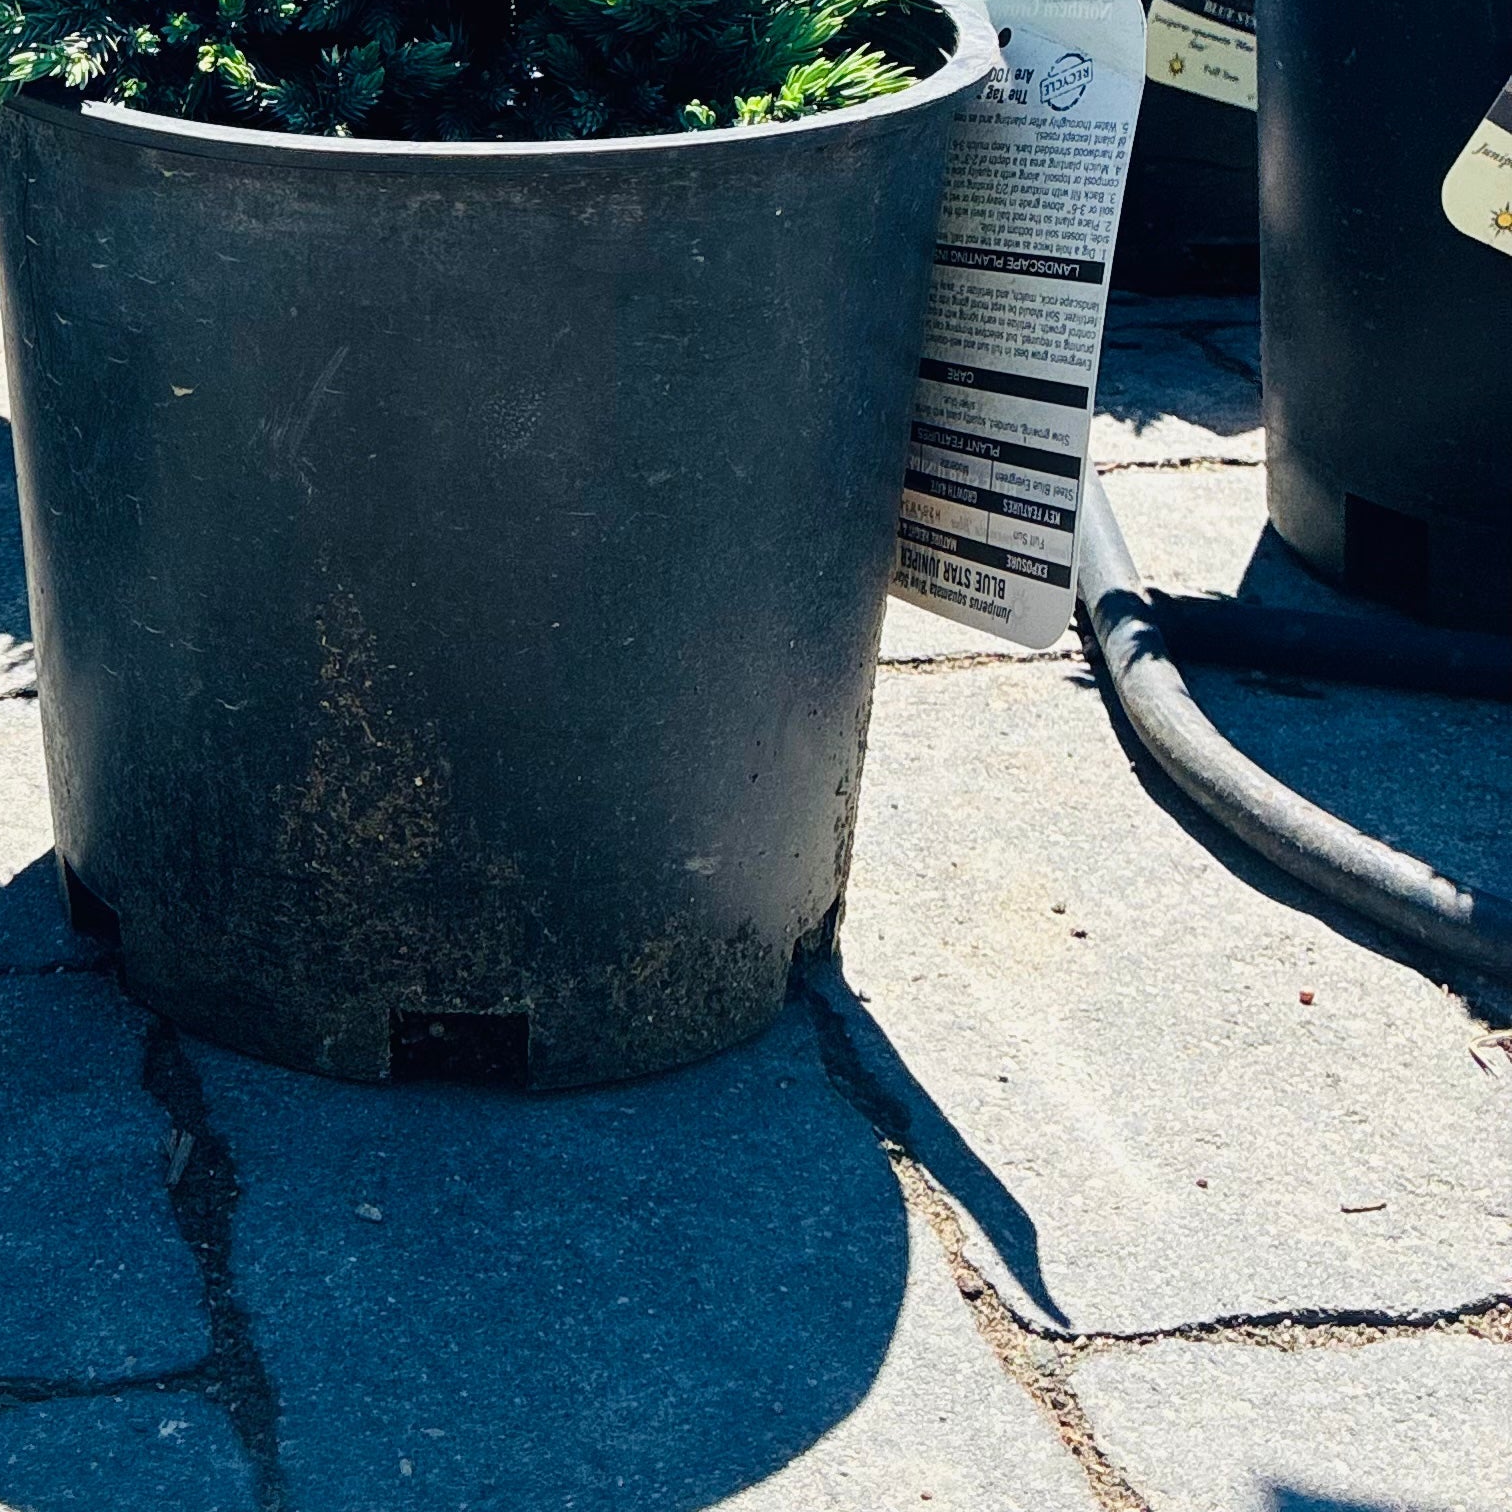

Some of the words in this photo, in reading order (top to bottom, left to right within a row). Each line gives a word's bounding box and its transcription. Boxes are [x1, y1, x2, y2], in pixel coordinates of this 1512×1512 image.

[1015, 68, 1034, 84] Are
[1043, 66, 1089, 96] RECYCLE
[986, 86, 1005, 103] Tag
[1009, 88, 1027, 105] The
[979, 113, 993, 125] and
[995, 112, 1027, 127] planting
[1029, 116, 1048, 128] after
[1050, 116, 1092, 131] thoroughly
[1094, 120, 1117, 133] Water
[1062, 131, 1091, 145] (except
[1094, 134, 1115, 146] plant
[1118, 137, 1126, 147] of
[992, 140, 1011, 153] Keep
[1014, 143, 1032, 154] bark.
[1034, 144, 1072, 157] shredded
[979, 155, 987, 165] of
[1074, 147, 1113, 161] hardwood
[1116, 150, 1125, 160] or
[1030, 159, 1046, 168] area
[1048, 158, 1081, 172] planting
[1084, 163, 1109, 174] Mulch
[1001, 170, 1017, 182] with
[1019, 169, 1040, 183] along
[1042, 172, 1070, 186] topsoil,
[1073, 176, 1082, 184] or
[1084, 175, 1119, 189] compost
[1011, 185, 1019, 195] of
[1020, 185, 1049, 198] mixture
[1051, 188, 1068, 199] with
[986, 193, 1007, 207] heavy
[1009, 198, 1016, 208] in
[1018, 196, 1040, 211] grade
[1084, 191, 1104, 203] Back
[1042, 201, 1064, 213] above
[1088, 206, 1097, 215] or
[1099, 207, 1114, 218] soil
[997, 210, 1010, 222] ball
[1012, 212, 1027, 223] root
[1029, 214, 1041, 225] the
[1043, 215, 1053, 224] so
[1055, 214, 1075, 228] plant
[997, 224, 1005, 235] of
[1078, 218, 1100, 231] Place
[1007, 225, 1033, 238] bottom
[1035, 228, 1043, 239] in
[1045, 229, 1059, 241] soil
[1061, 231, 1087, 244] loosen
[980, 236, 992, 247] the
[1003, 238, 1021, 250] wide
[1022, 240, 1031, 250] as
[1033, 242, 1053, 254] twice
[1055, 244, 1073, 256] hole
[1074, 246, 1079, 255] a
[1082, 245, 1096, 259] Dig
[950, 250, 1004, 269] PLANTING
[1006, 256, 1080, 278] LANDSCAPE
[1007, 304, 1017, 315] be
[1060, 294, 1100, 314] landscape
[1018, 305, 1043, 319] should
[1045, 310, 1060, 322] Soil
[1007, 318, 1036, 332] Fertilize
[1005, 332, 1017, 343] but
[1069, 328, 1096, 342] control
[1063, 339, 1094, 355] pruning
[1013, 347, 1029, 361] best
[1049, 351, 1092, 371] Evergreens
[946, 367, 975, 384] CARE
[917, 427, 964, 449] FEATURES
[966, 438, 1000, 457] PLANT
[995, 468, 1031, 491] Evergreen
[1053, 485, 1074, 501] Steel
[1002, 498, 1042, 521] FEATURES
[1044, 508, 1061, 525] KEY
[899, 547, 941, 578] JUNIPER
[1006, 554, 1049, 579] EXPOSURE
[942, 561, 972, 588] STAR
[974, 571, 1007, 600] BLUE
[968, 595, 1011, 624] Juniperus
